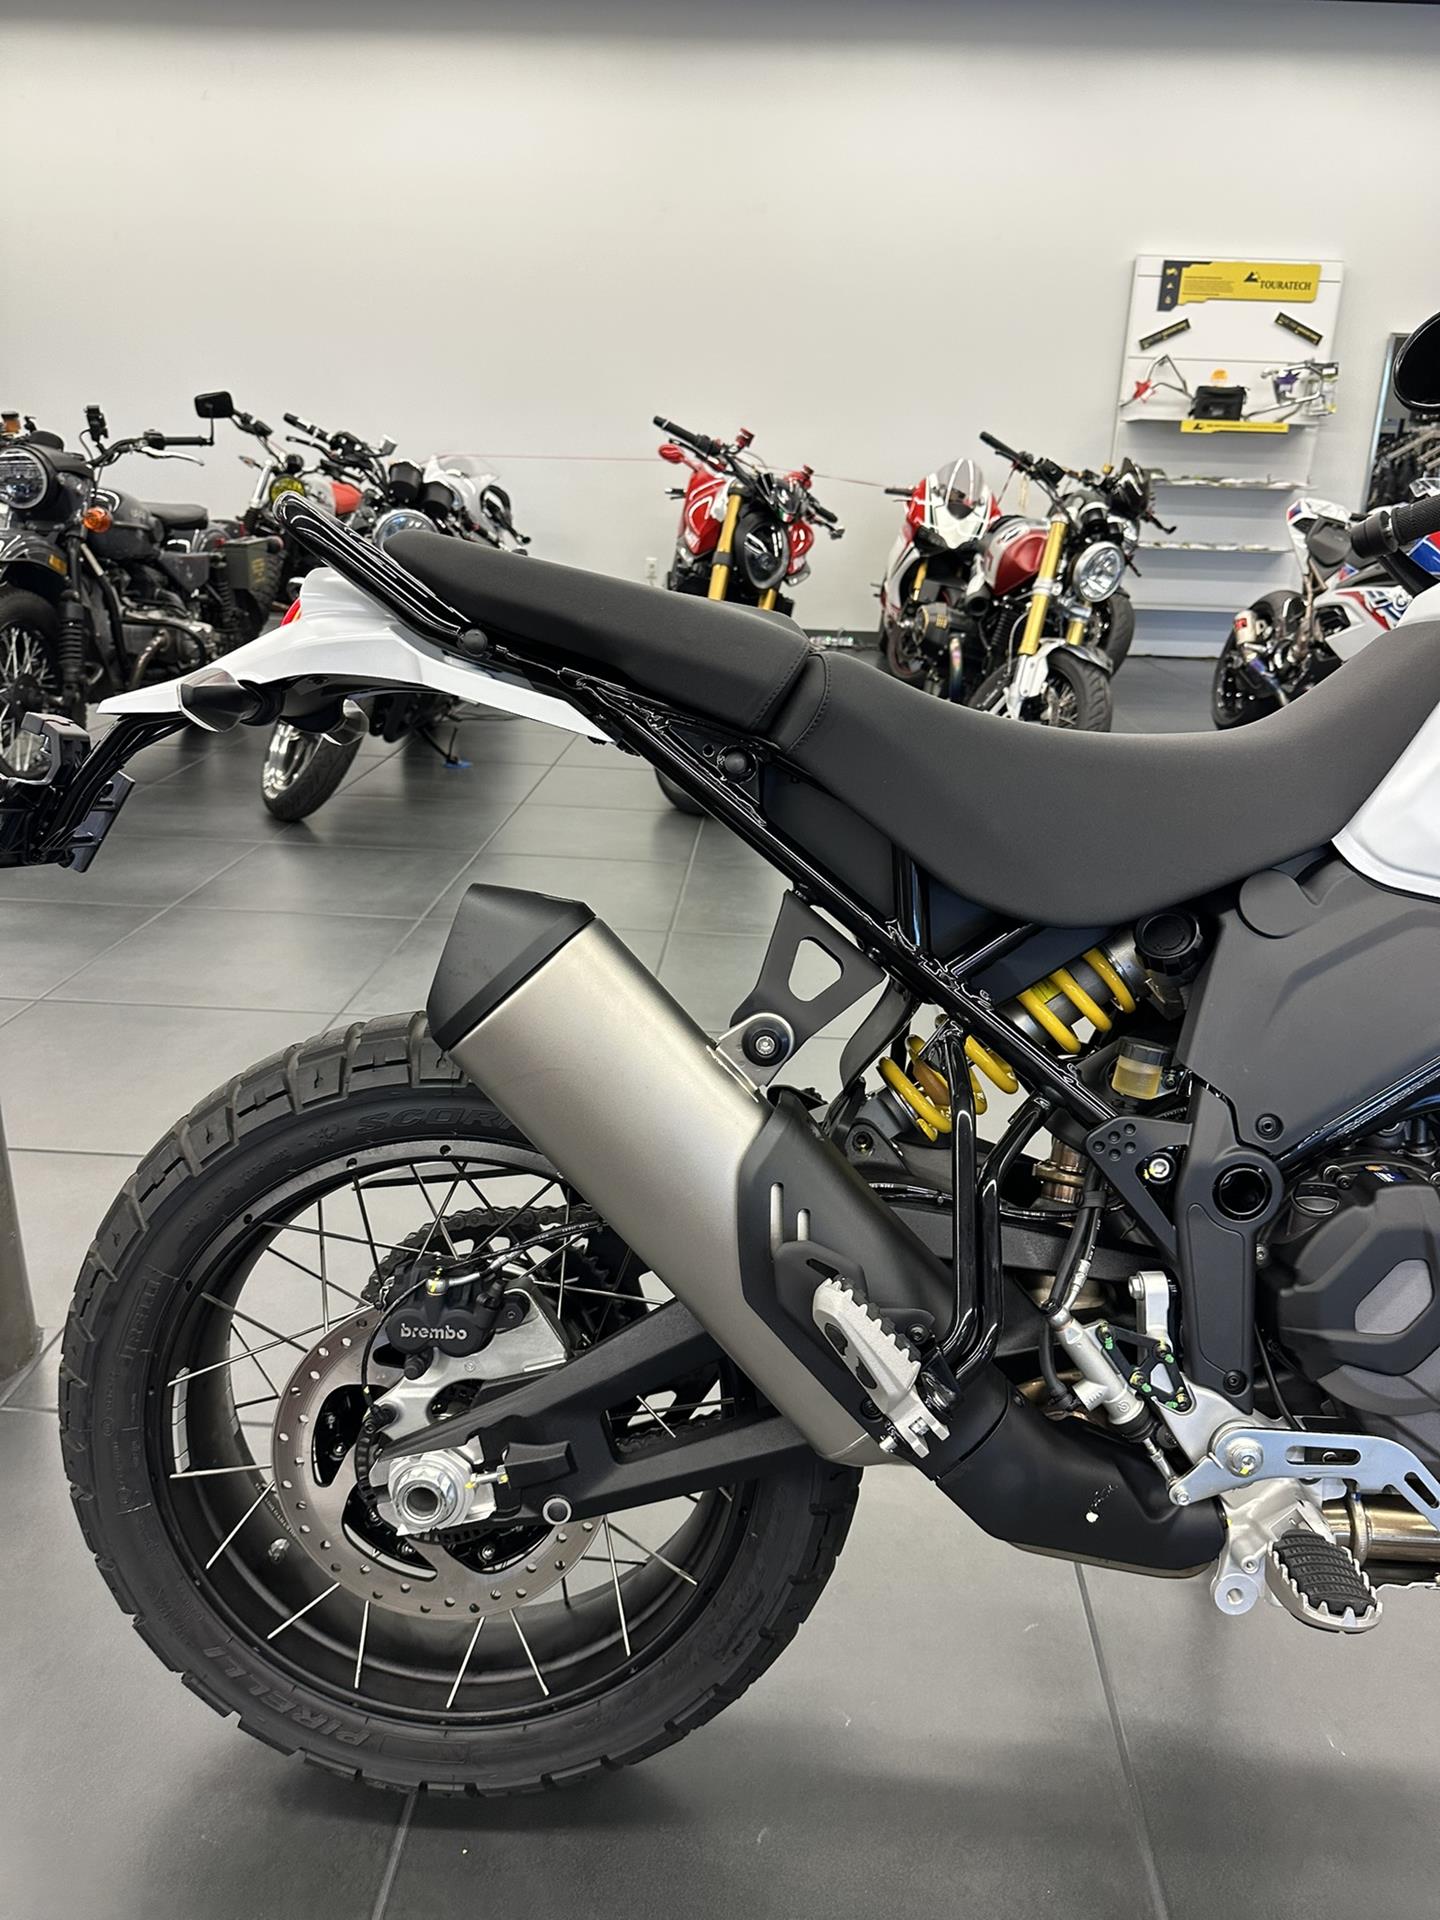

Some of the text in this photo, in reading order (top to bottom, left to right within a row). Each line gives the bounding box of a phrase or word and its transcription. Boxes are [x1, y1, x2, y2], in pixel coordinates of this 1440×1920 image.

[1260, 280, 1312, 291] TOURATECH
[400, 1323, 468, 1340] brembo
[204, 1646, 370, 1746] PIRELLI
